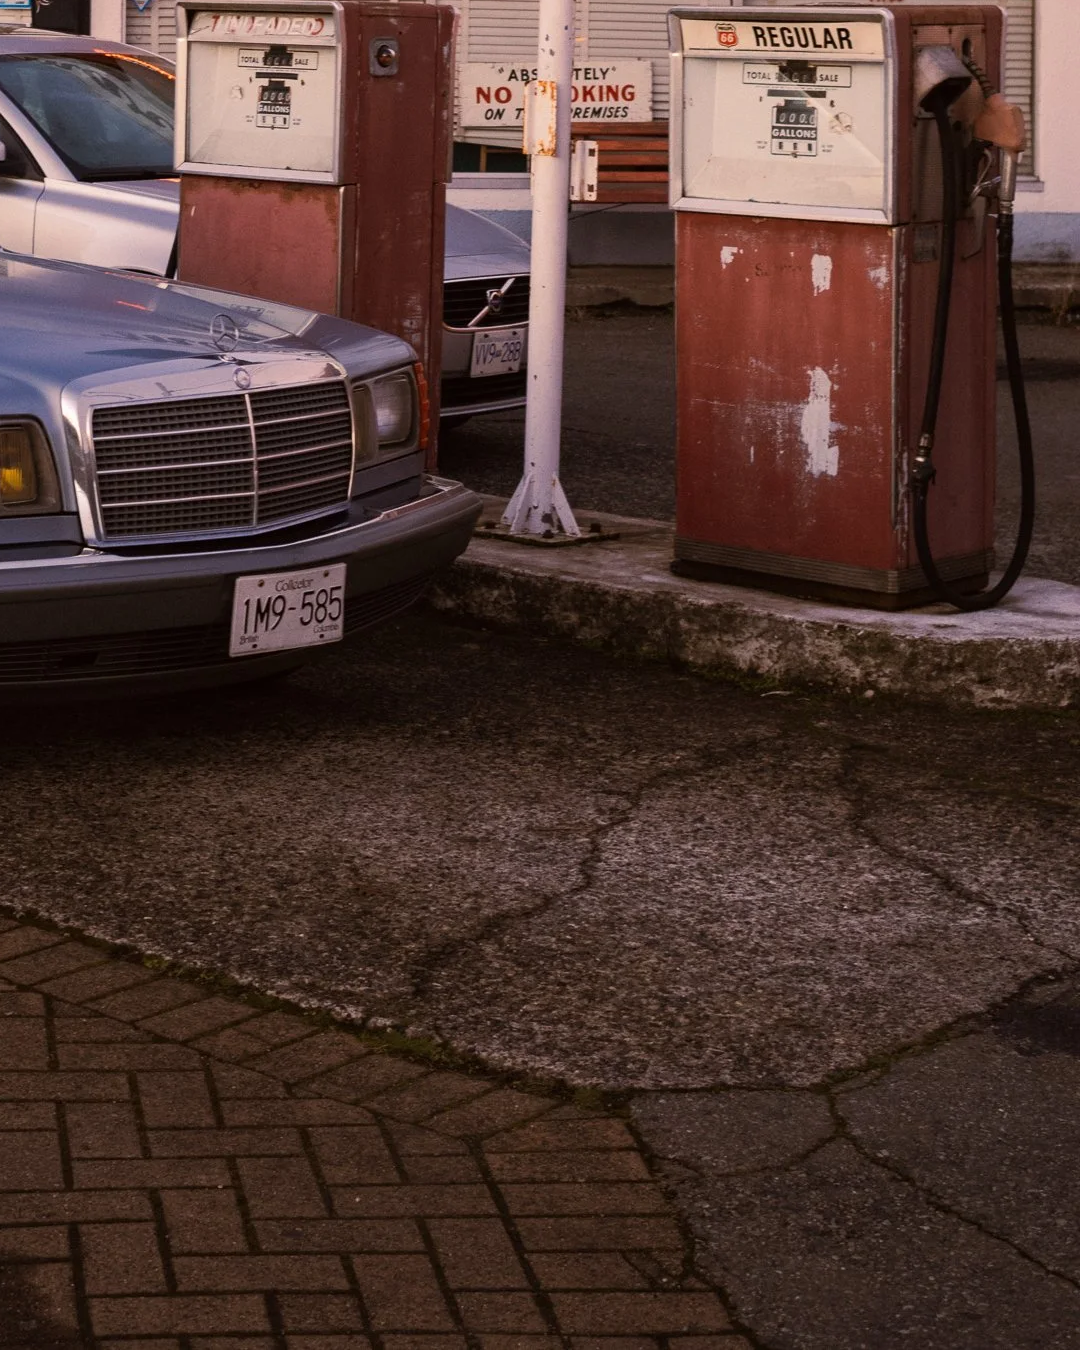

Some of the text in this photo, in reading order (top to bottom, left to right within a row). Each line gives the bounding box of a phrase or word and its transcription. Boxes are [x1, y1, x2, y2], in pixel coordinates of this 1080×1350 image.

[752, 25, 853, 50] REGULAR
[240, 55, 260, 65] TOTAL
[294, 57, 309, 66] SALE
[746, 71, 772, 81] TOTAL
[819, 73, 839, 83] SALE
[476, 86, 512, 104] NO
[257, 103, 290, 114] GALLONS
[484, 108, 505, 121] ON
[772, 128, 817, 140] GALLONS
[275, 578, 314, 592] Collector
[243, 585, 342, 635] 1M9-585
